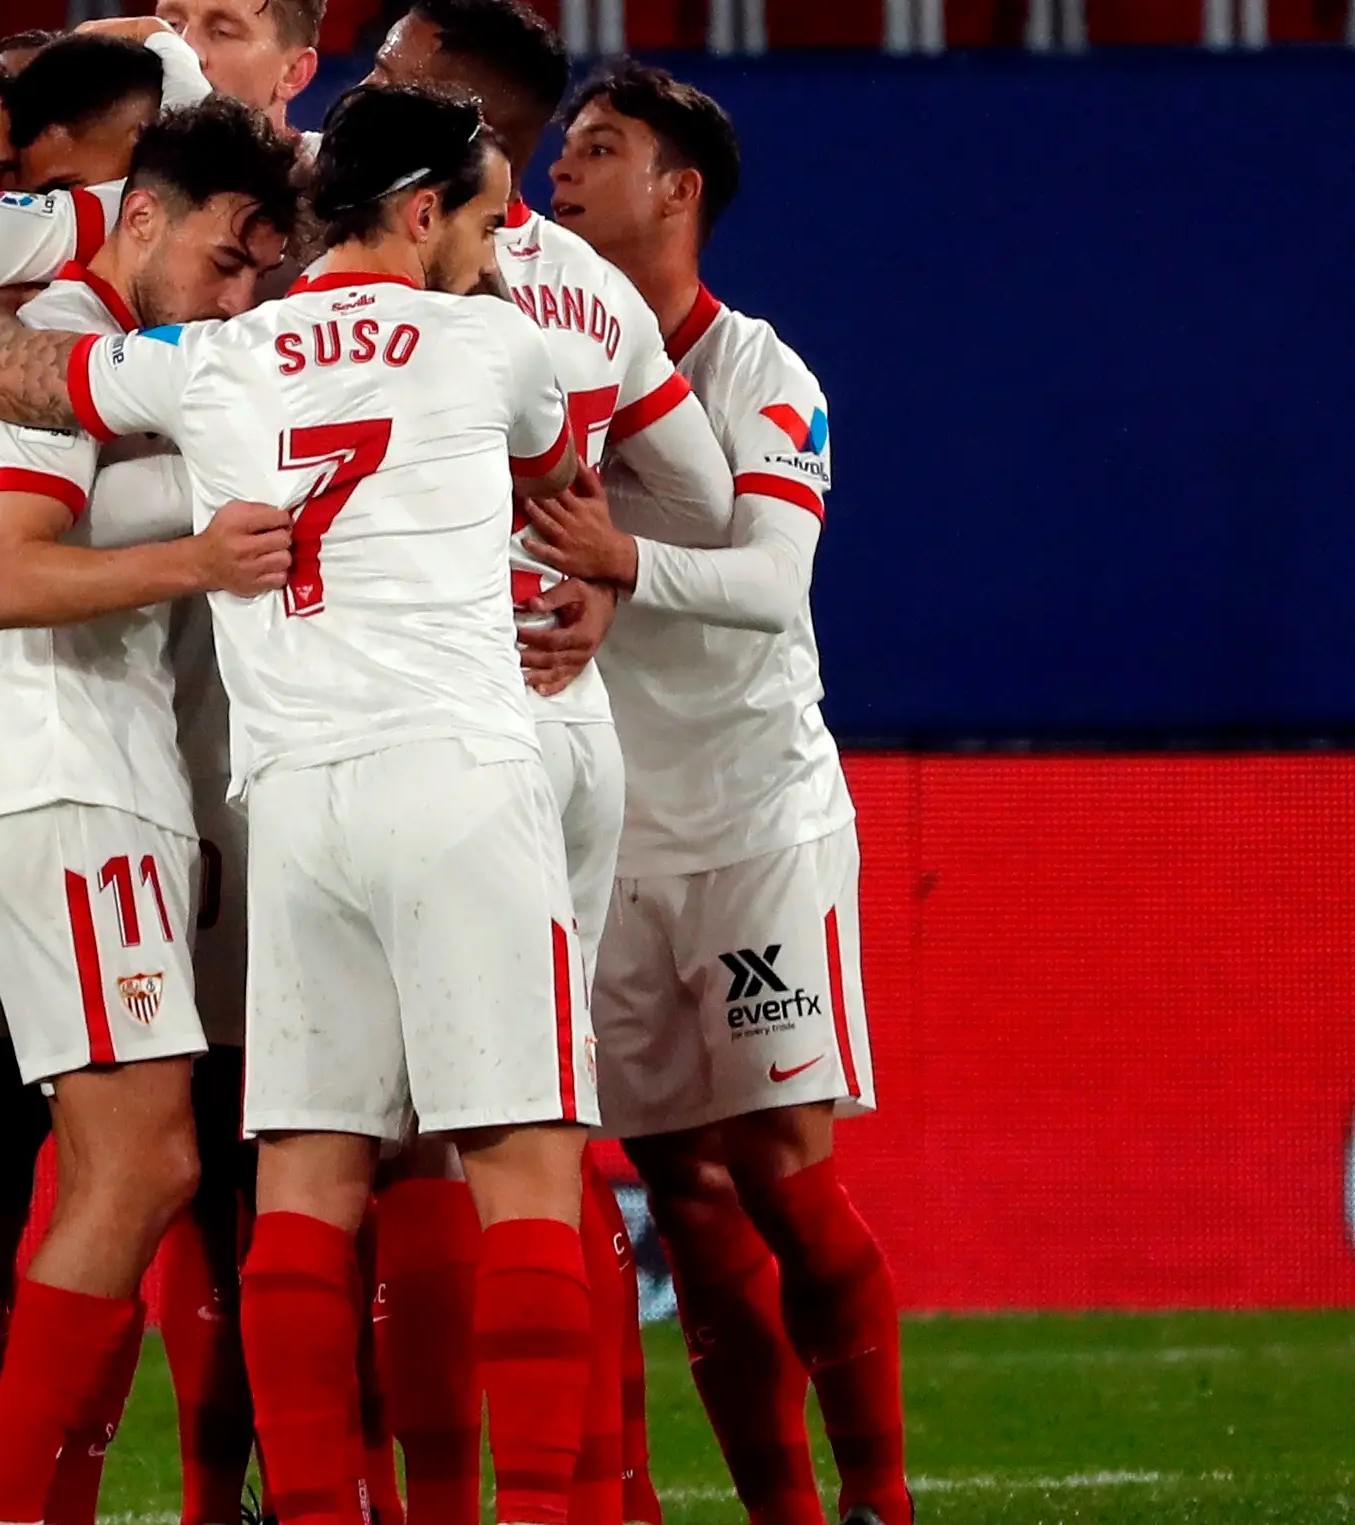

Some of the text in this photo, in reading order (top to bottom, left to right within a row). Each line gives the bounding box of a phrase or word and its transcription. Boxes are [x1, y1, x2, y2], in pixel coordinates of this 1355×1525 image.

[275, 319, 420, 375] SUSO
[510, 284, 621, 361] NANDO
[278, 417, 393, 617] 7
[97, 854, 174, 948] 11
[727, 988, 822, 1029] everfx
